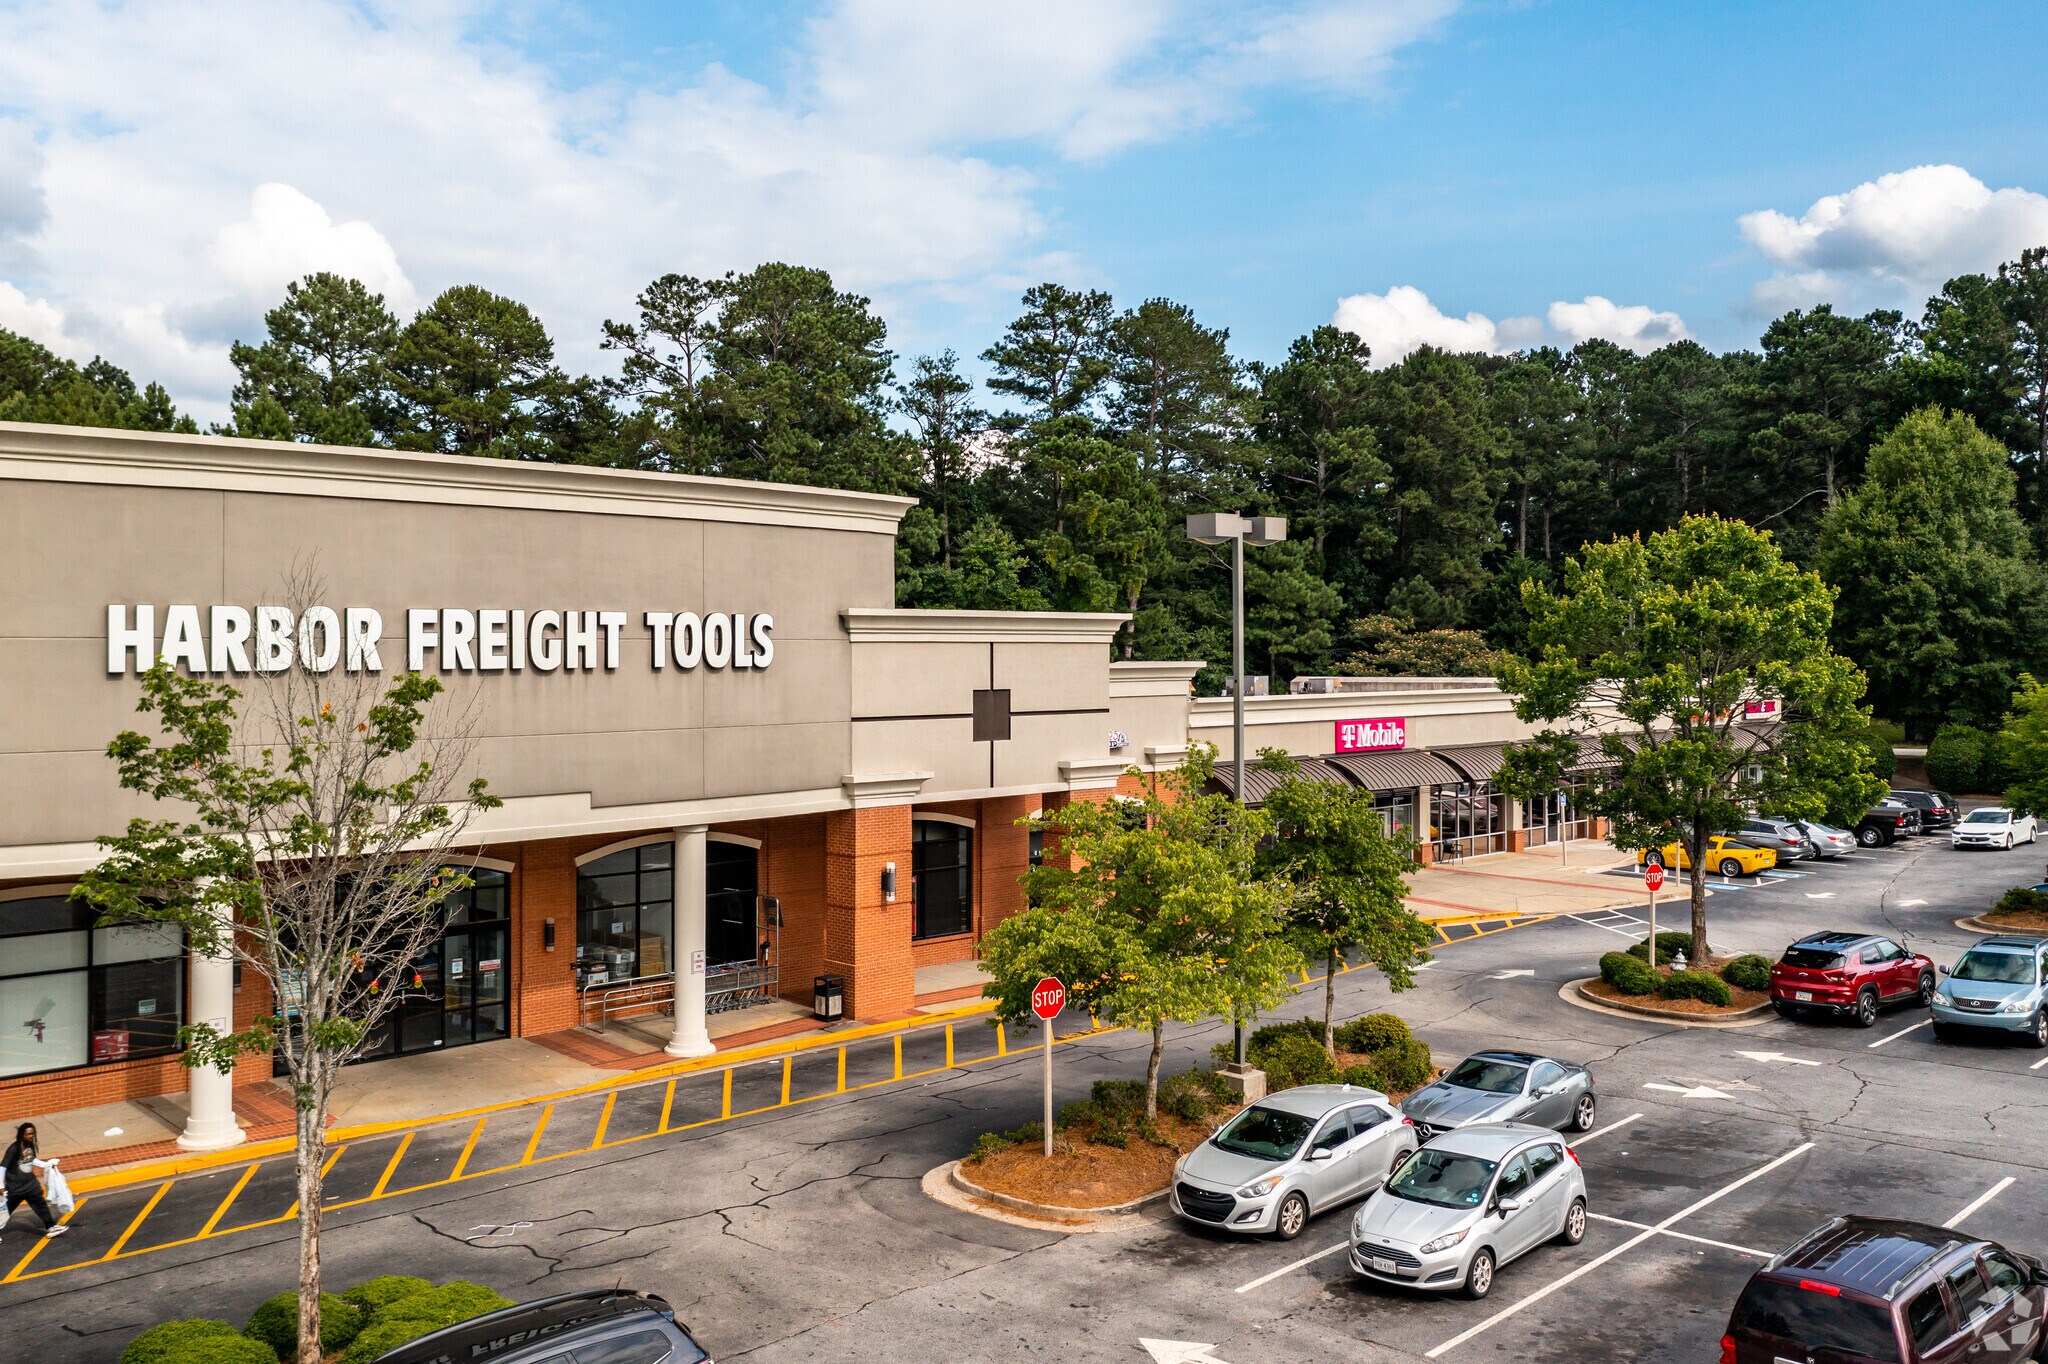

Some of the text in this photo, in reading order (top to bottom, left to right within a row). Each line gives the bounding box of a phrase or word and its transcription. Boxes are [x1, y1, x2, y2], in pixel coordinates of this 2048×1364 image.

[108, 604, 774, 673] HARBOR FREIGHT TOOLS
[1646, 872, 1662, 884] STOP
[1035, 989, 1063, 1008] STOP
